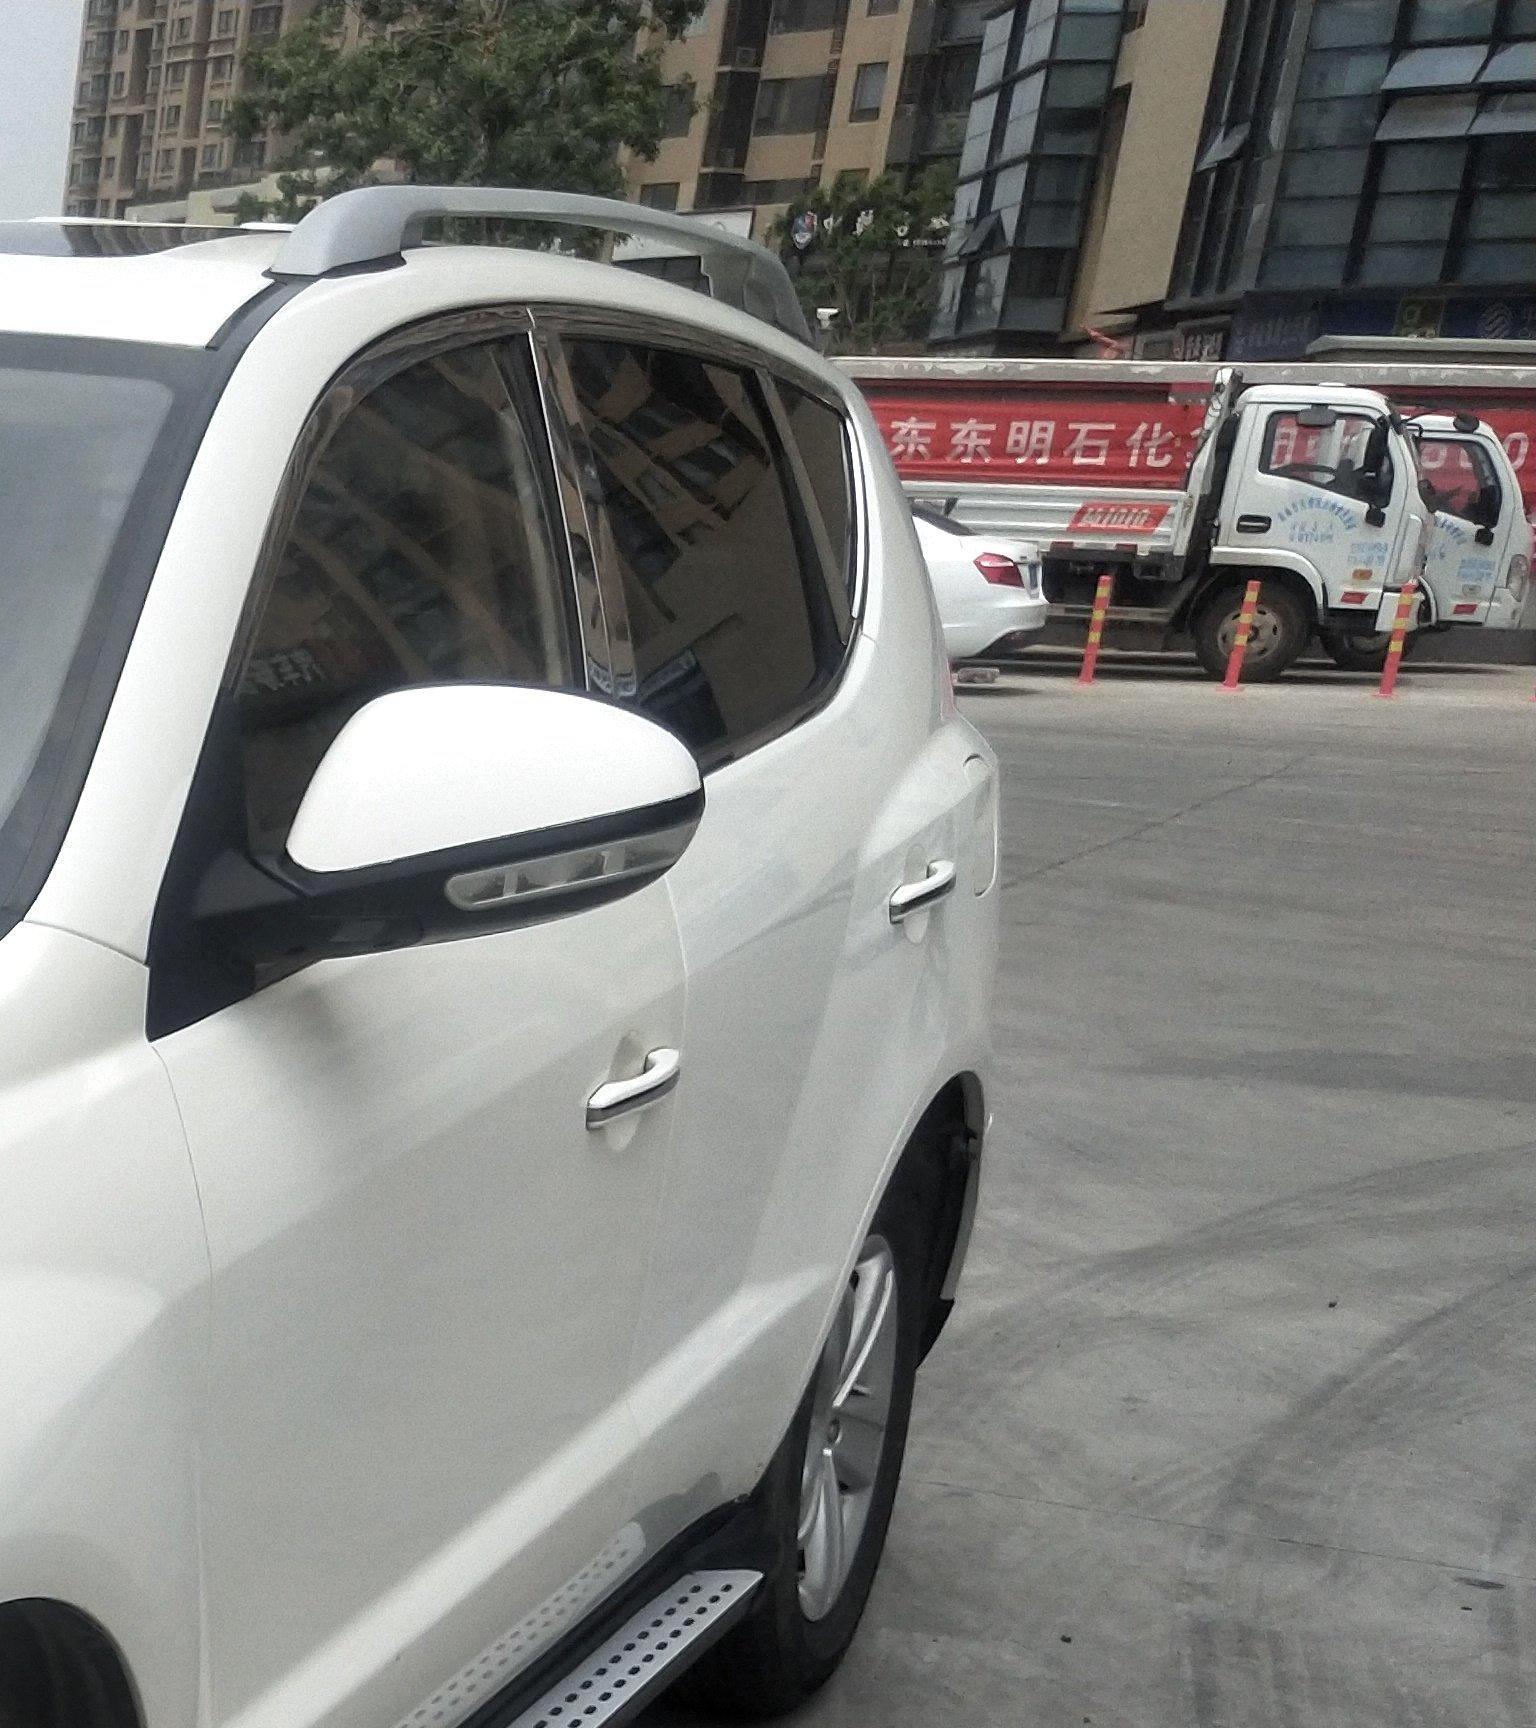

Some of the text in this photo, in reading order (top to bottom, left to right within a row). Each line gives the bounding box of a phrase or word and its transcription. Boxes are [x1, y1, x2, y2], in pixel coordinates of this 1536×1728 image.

[890, 417, 1203, 468] 东东明石化
